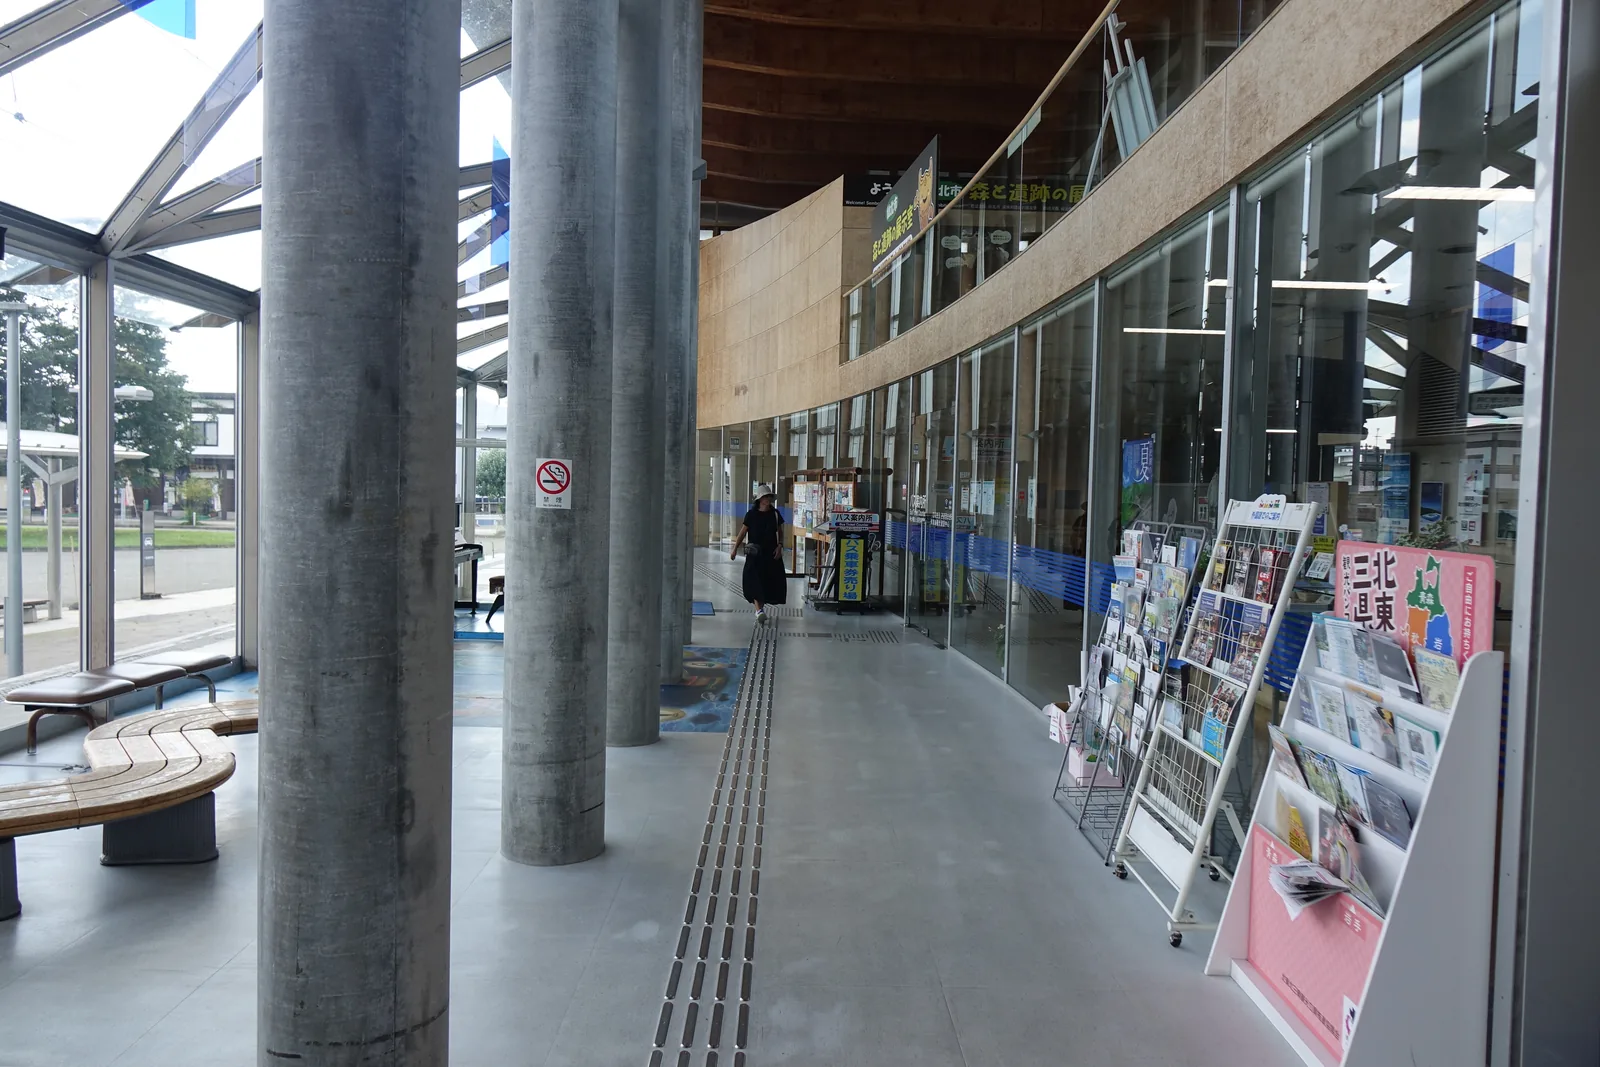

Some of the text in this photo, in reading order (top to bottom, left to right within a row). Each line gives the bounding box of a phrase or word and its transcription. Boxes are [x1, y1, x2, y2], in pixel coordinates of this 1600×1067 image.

[835, 513, 873, 522] バス案内所
[1418, 591, 1435, 605] 青森
